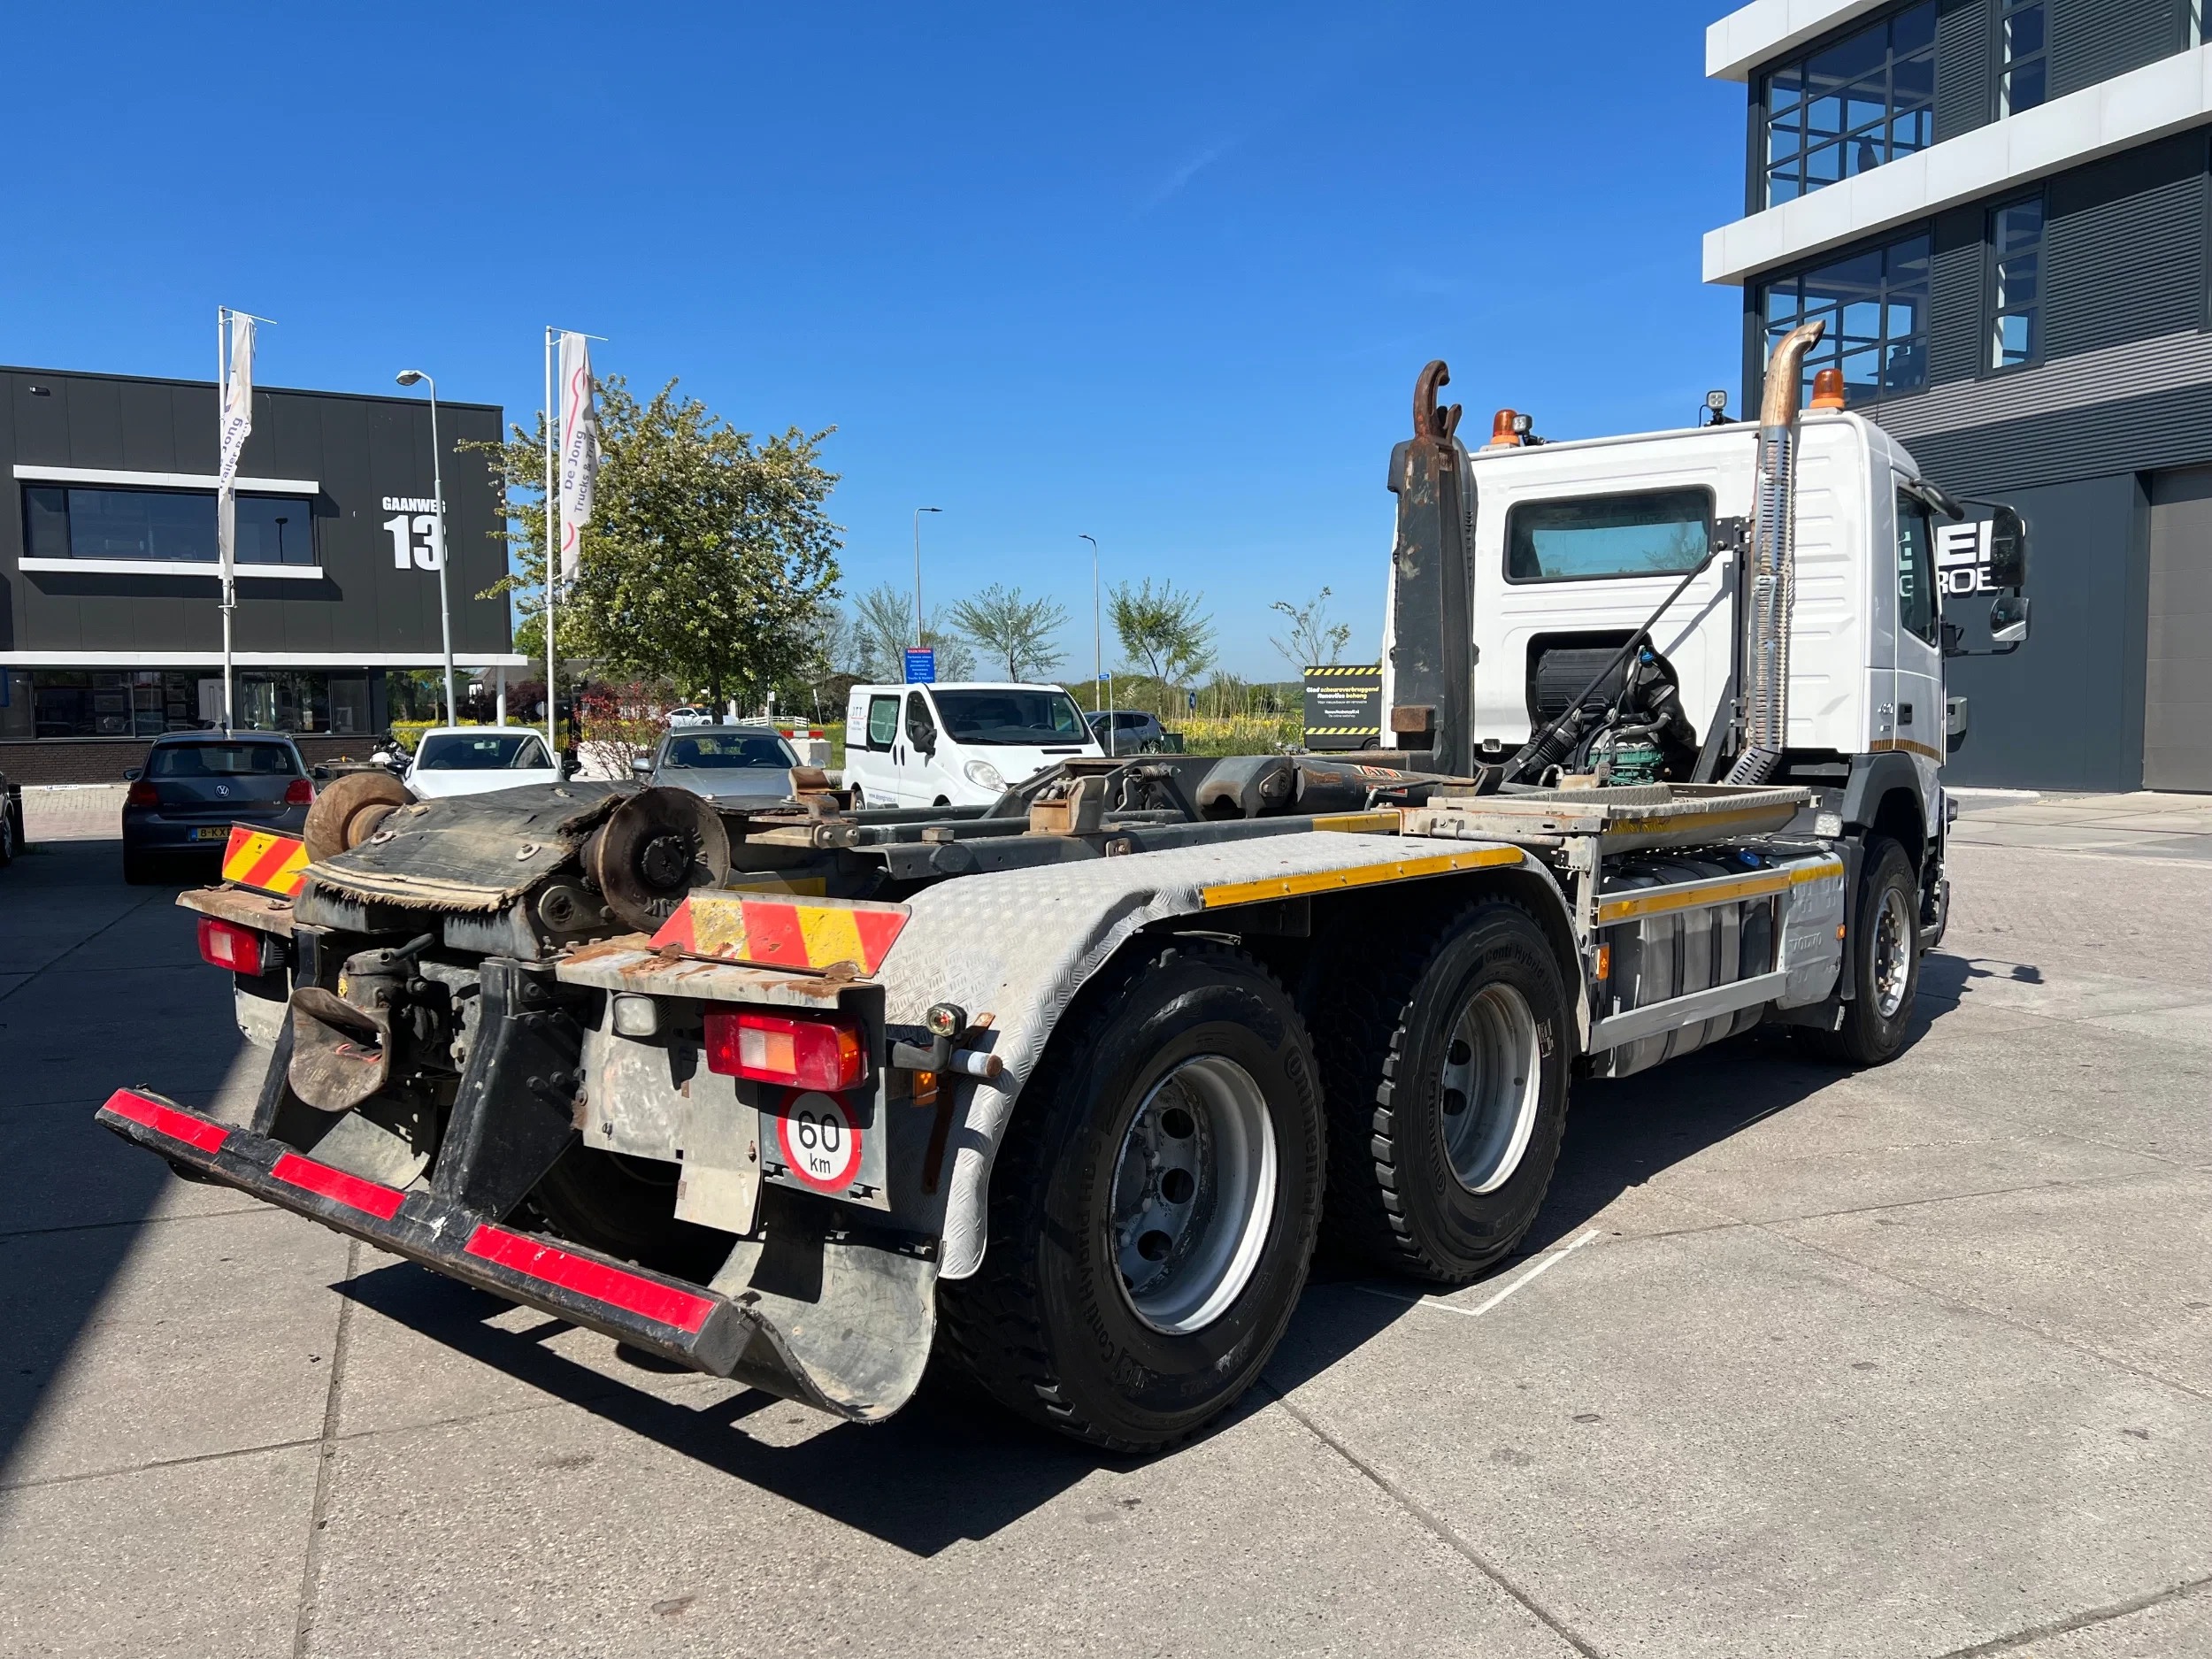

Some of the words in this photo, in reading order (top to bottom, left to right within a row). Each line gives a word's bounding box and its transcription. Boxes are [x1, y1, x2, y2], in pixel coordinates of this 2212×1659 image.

[568, 430, 586, 466] Jong
[219, 452, 237, 488] railer
[565, 469, 575, 490] De
[574, 474, 589, 512] Trucks
[584, 463, 591, 472] &
[383, 514, 449, 571] 13
[798, 1110, 840, 1153] 60
[810, 1152, 831, 1174] km
